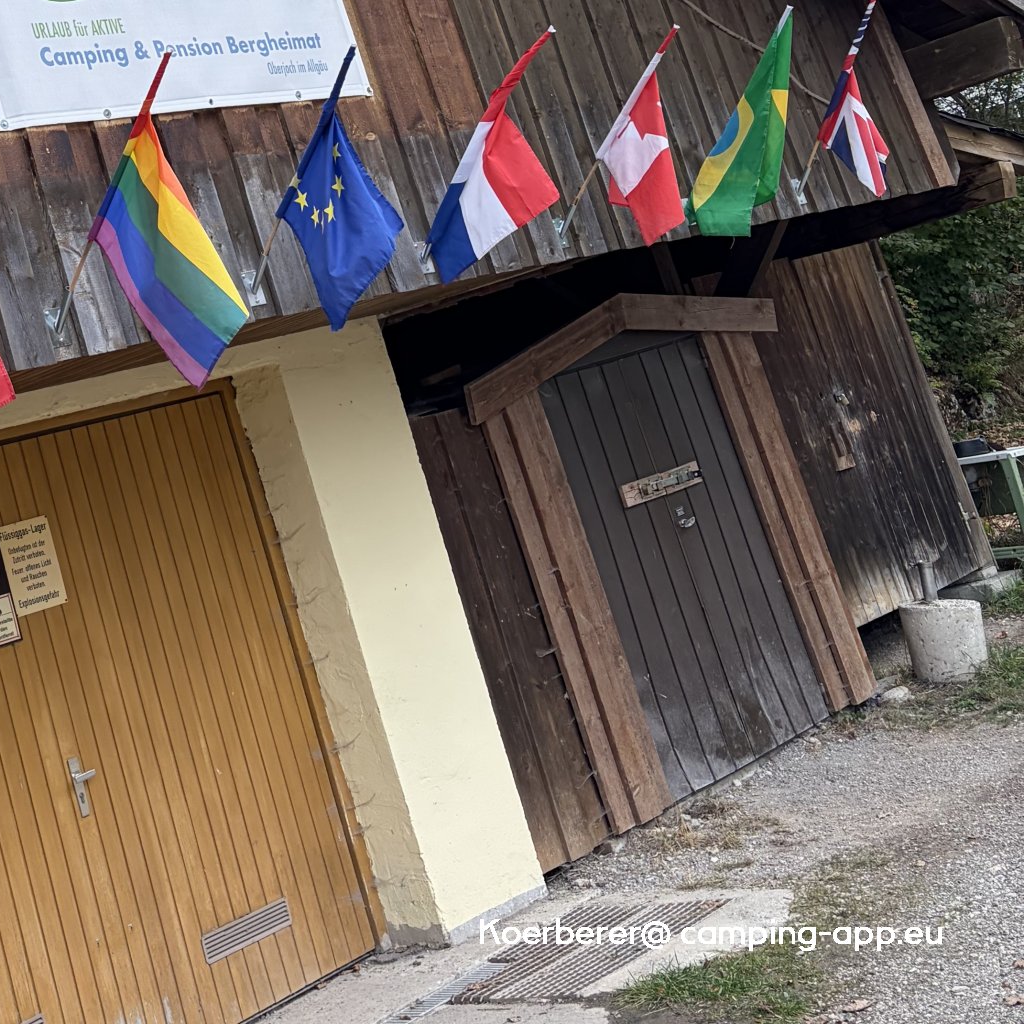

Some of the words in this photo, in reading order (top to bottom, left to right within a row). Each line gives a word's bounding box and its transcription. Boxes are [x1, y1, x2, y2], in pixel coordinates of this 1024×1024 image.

[31, 21, 72, 39] URLAUB
[72, 19, 89, 37] für
[91, 18, 125, 36] AKTIVE
[40, 43, 129, 70] Camping
[134, 40, 151, 60] &
[152, 37, 224, 58] Pension
[226, 31, 322, 57] Bergheimat
[267, 61, 297, 76] Oberjoch
[298, 61, 307, 73] im
[307, 59, 328, 75] Allgäu
[0, 523, 46, 542] Flüssiggas-Lager
[18, 590, 60, 609] Explosionsgefahr
